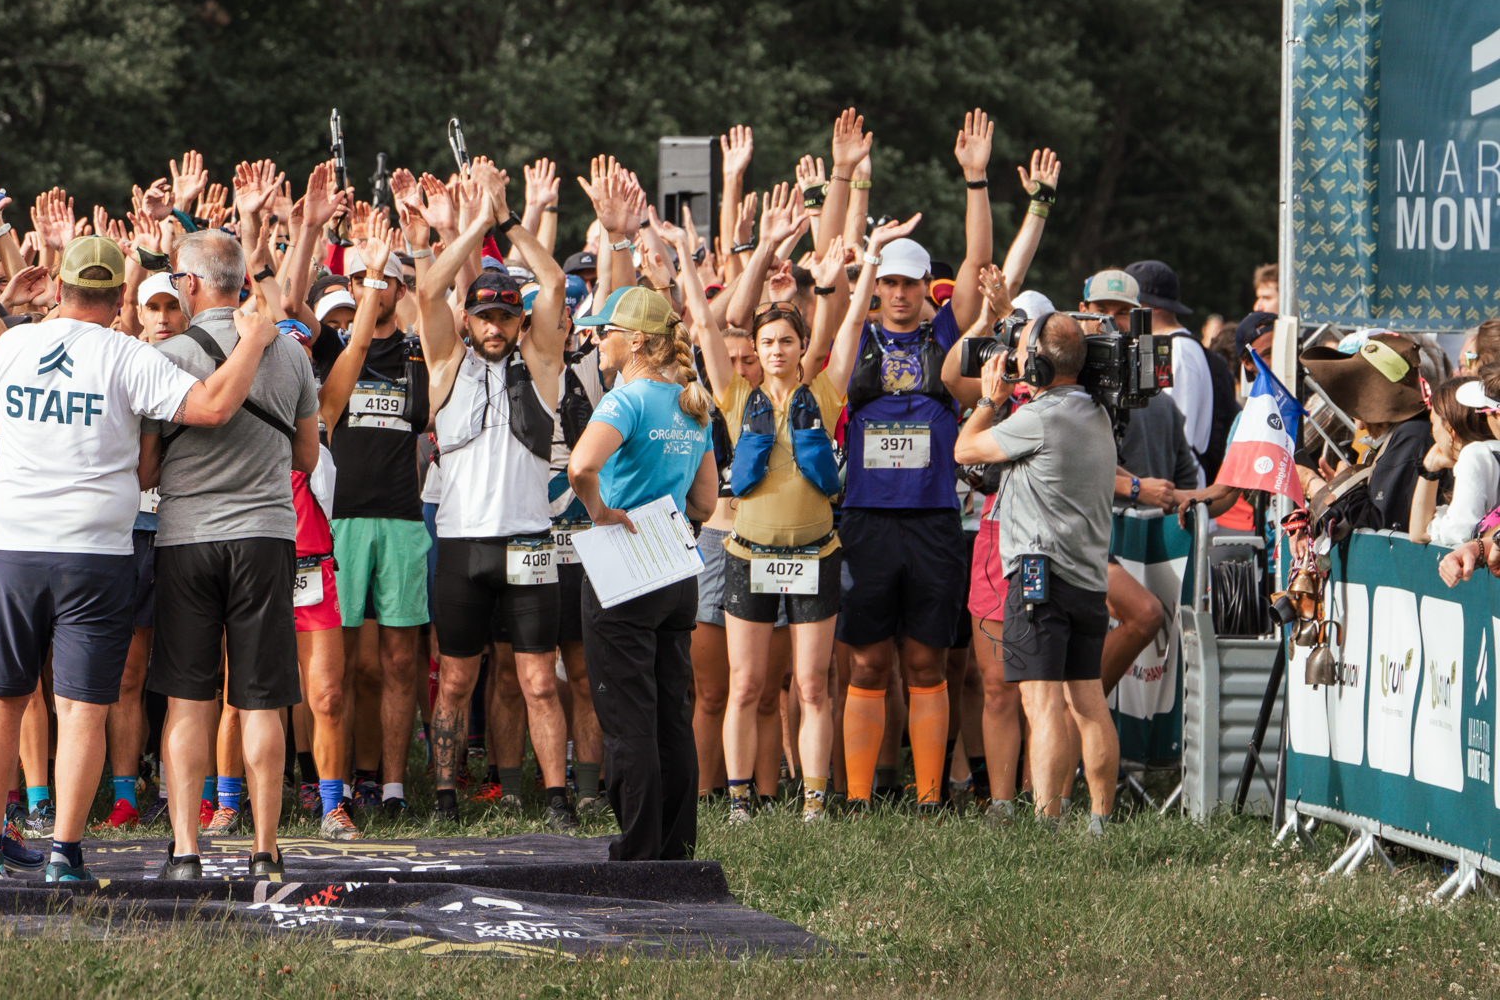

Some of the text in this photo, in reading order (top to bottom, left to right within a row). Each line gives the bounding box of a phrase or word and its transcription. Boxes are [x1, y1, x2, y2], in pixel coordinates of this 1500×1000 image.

[1396, 197, 1500, 250] MON
[6, 384, 104, 427] STAFF
[365, 397, 399, 412] 4139
[648, 429, 705, 443] ORGANISATION
[880, 438, 913, 451] 3971
[522, 553, 551, 567] 4081
[766, 562, 804, 576] 4072
